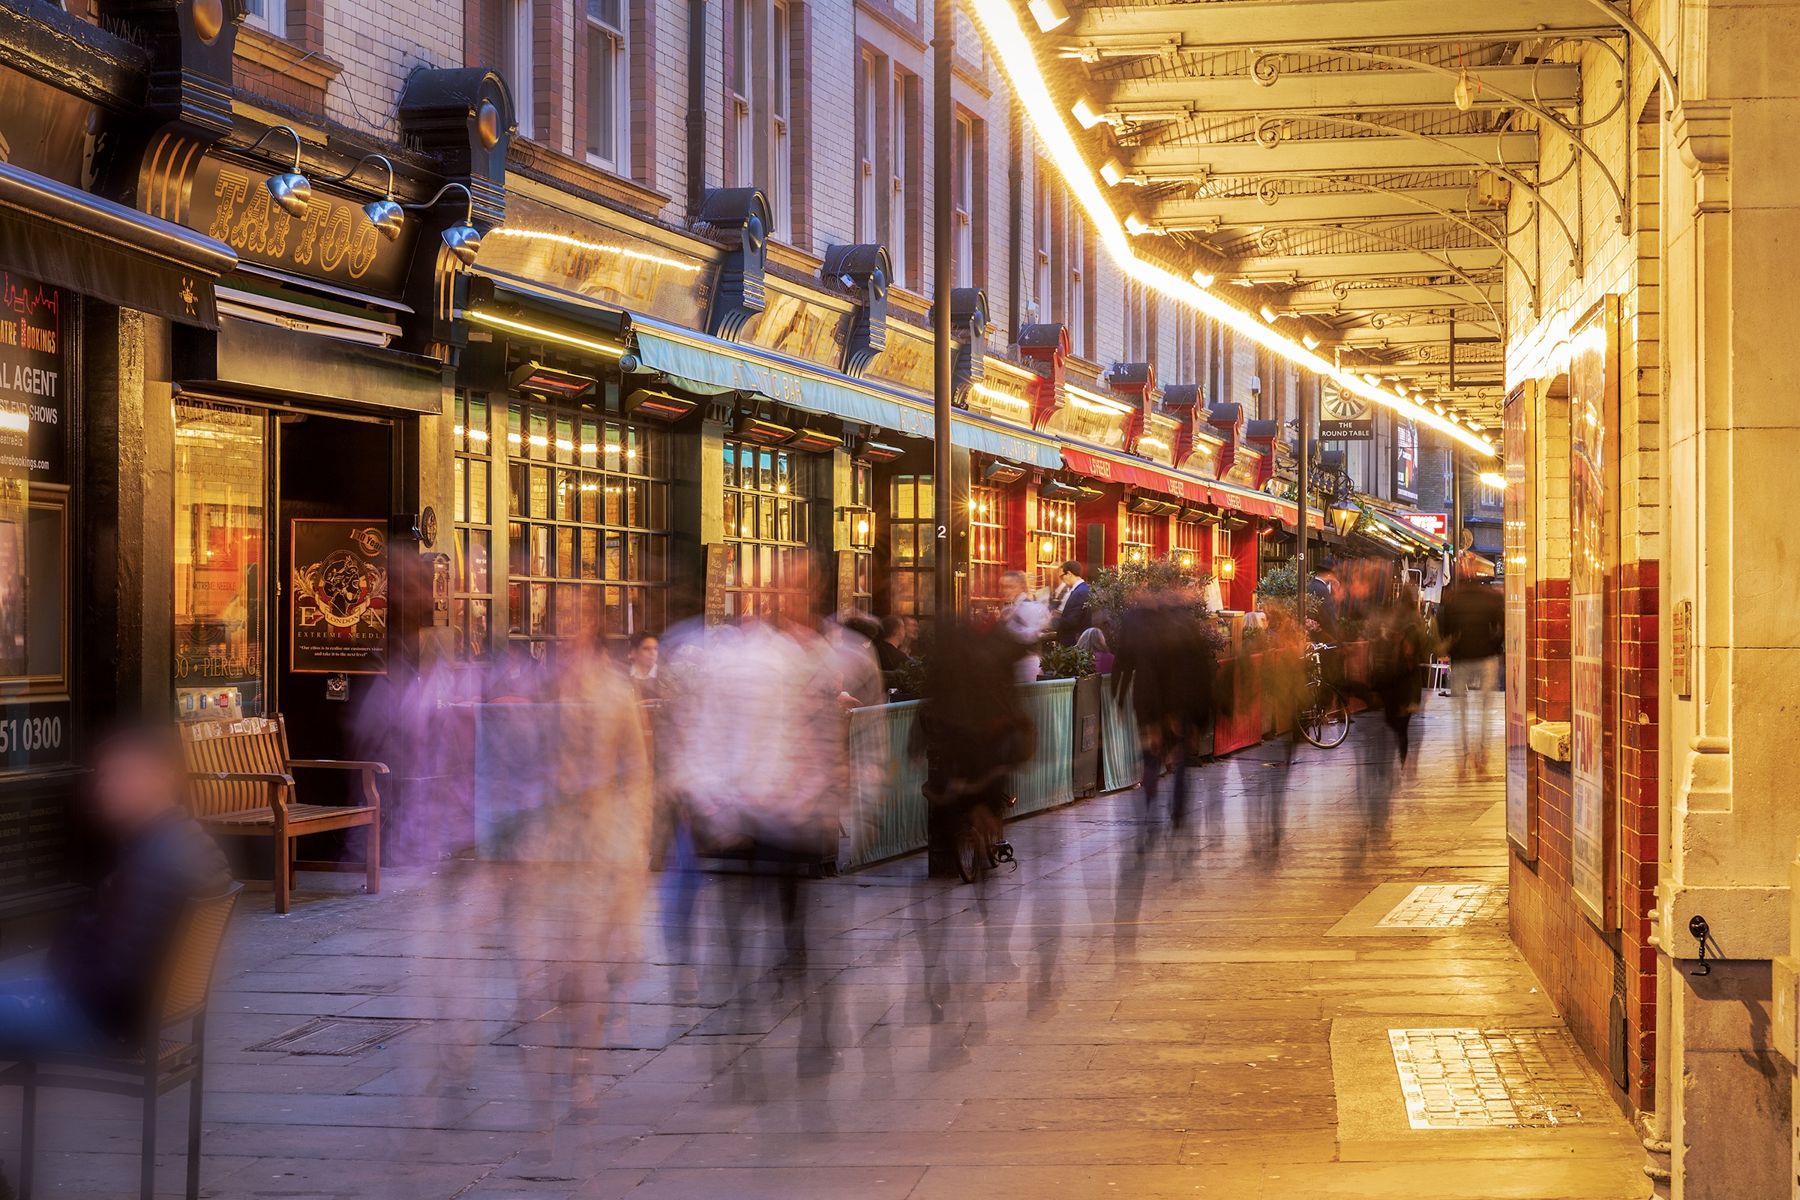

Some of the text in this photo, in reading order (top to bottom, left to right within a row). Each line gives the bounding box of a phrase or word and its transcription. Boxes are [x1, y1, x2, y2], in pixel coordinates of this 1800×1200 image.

[209, 169, 378, 278] TATTOO
[14, 365, 58, 397] AGENT
[29, 405, 58, 424] SHOWS
[937, 525, 946, 538] 2
[1299, 552, 1305, 561] 3
[326, 612, 360, 624] LONDON
[297, 631, 342, 639] EXTREME
[201, 657, 257, 677] PIERCING
[23, 716, 61, 751] 0300
